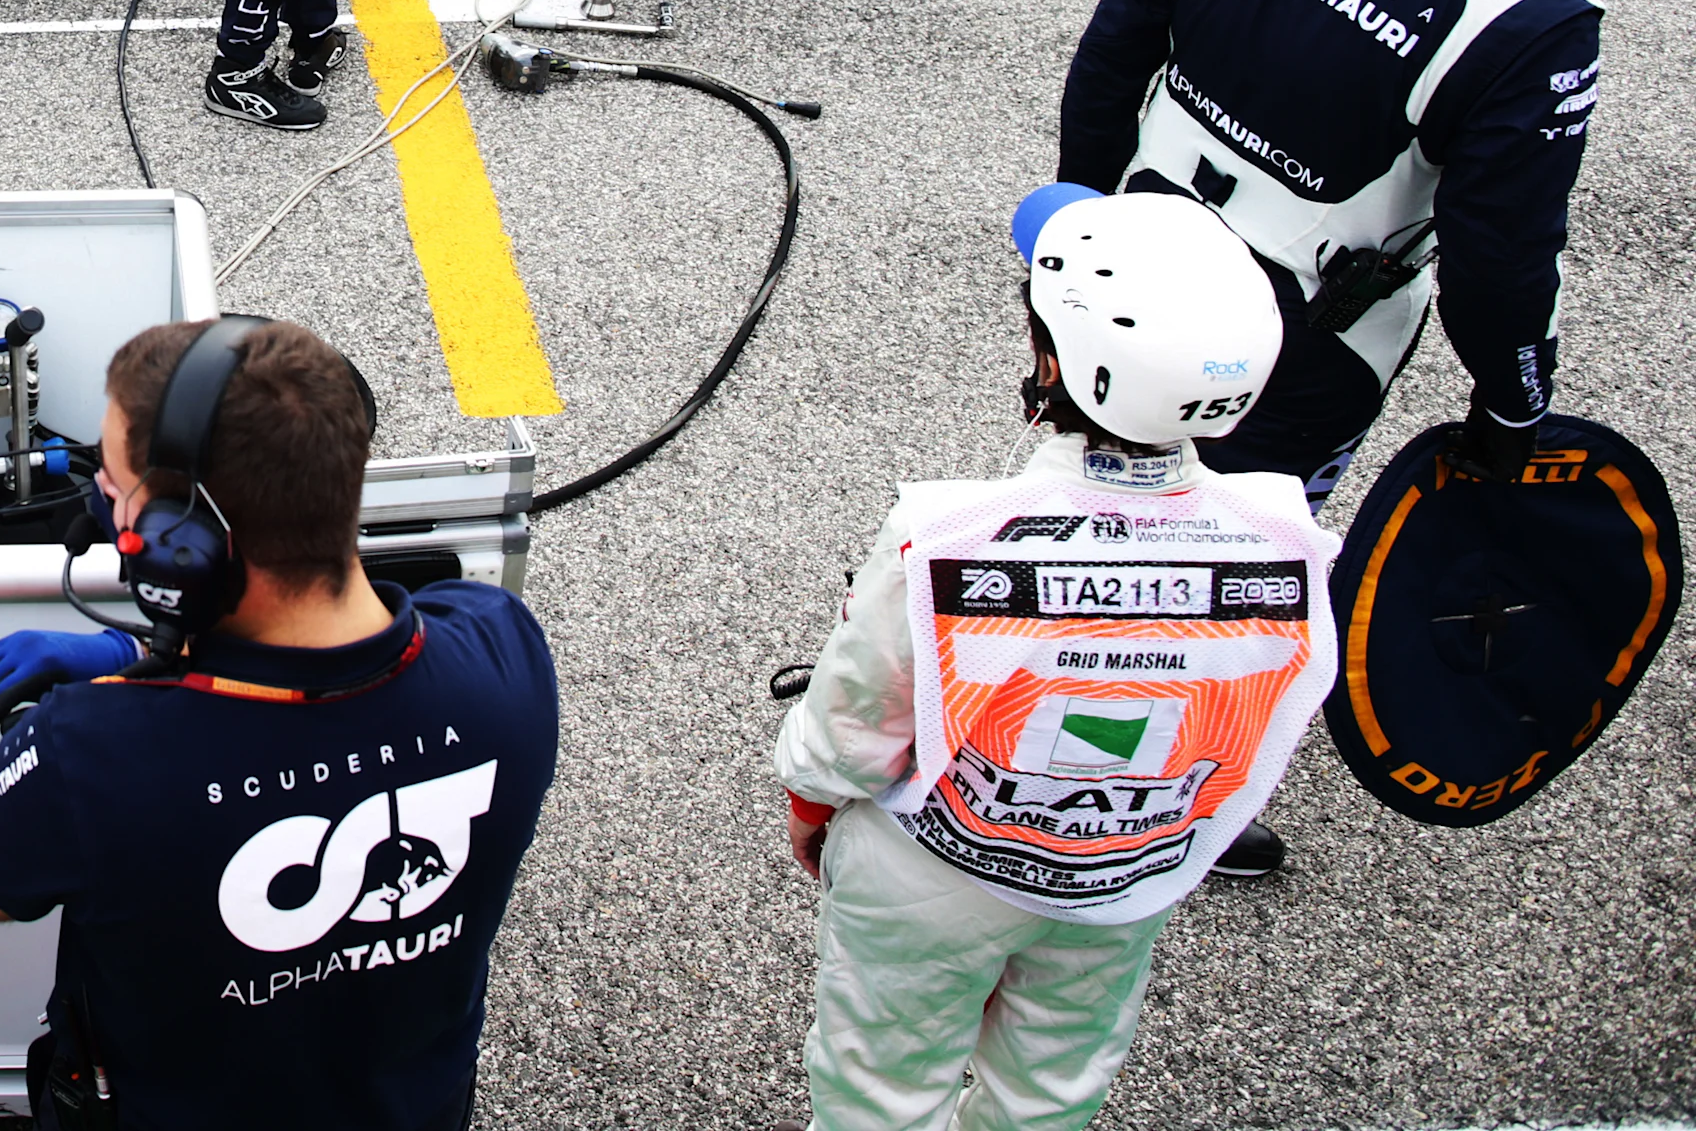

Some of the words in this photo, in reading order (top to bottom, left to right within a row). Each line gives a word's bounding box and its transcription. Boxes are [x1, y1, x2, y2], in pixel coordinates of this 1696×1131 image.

[1165, 61, 1326, 193] ALPHATAURI.COM
[1178, 391, 1254, 421] 153
[1134, 518, 1157, 530] FIA
[1136, 531, 1176, 543] World
[1221, 576, 1301, 606] 2020
[1056, 650, 1099, 670] GRID
[1104, 651, 1188, 671] MARSHAL
[207, 725, 461, 804] SCUDERIA
[954, 774, 982, 808] PIT
[983, 805, 1057, 832] LANE
[1062, 821, 1110, 836] ALL
[1116, 806, 1186, 834] TIMES
[925, 826, 995, 872] PREMIO
[1109, 852, 1181, 887] ROMAGNA
[976, 852, 1077, 881] EMIRATES
[219, 912, 464, 1006] ALPHATAURI
